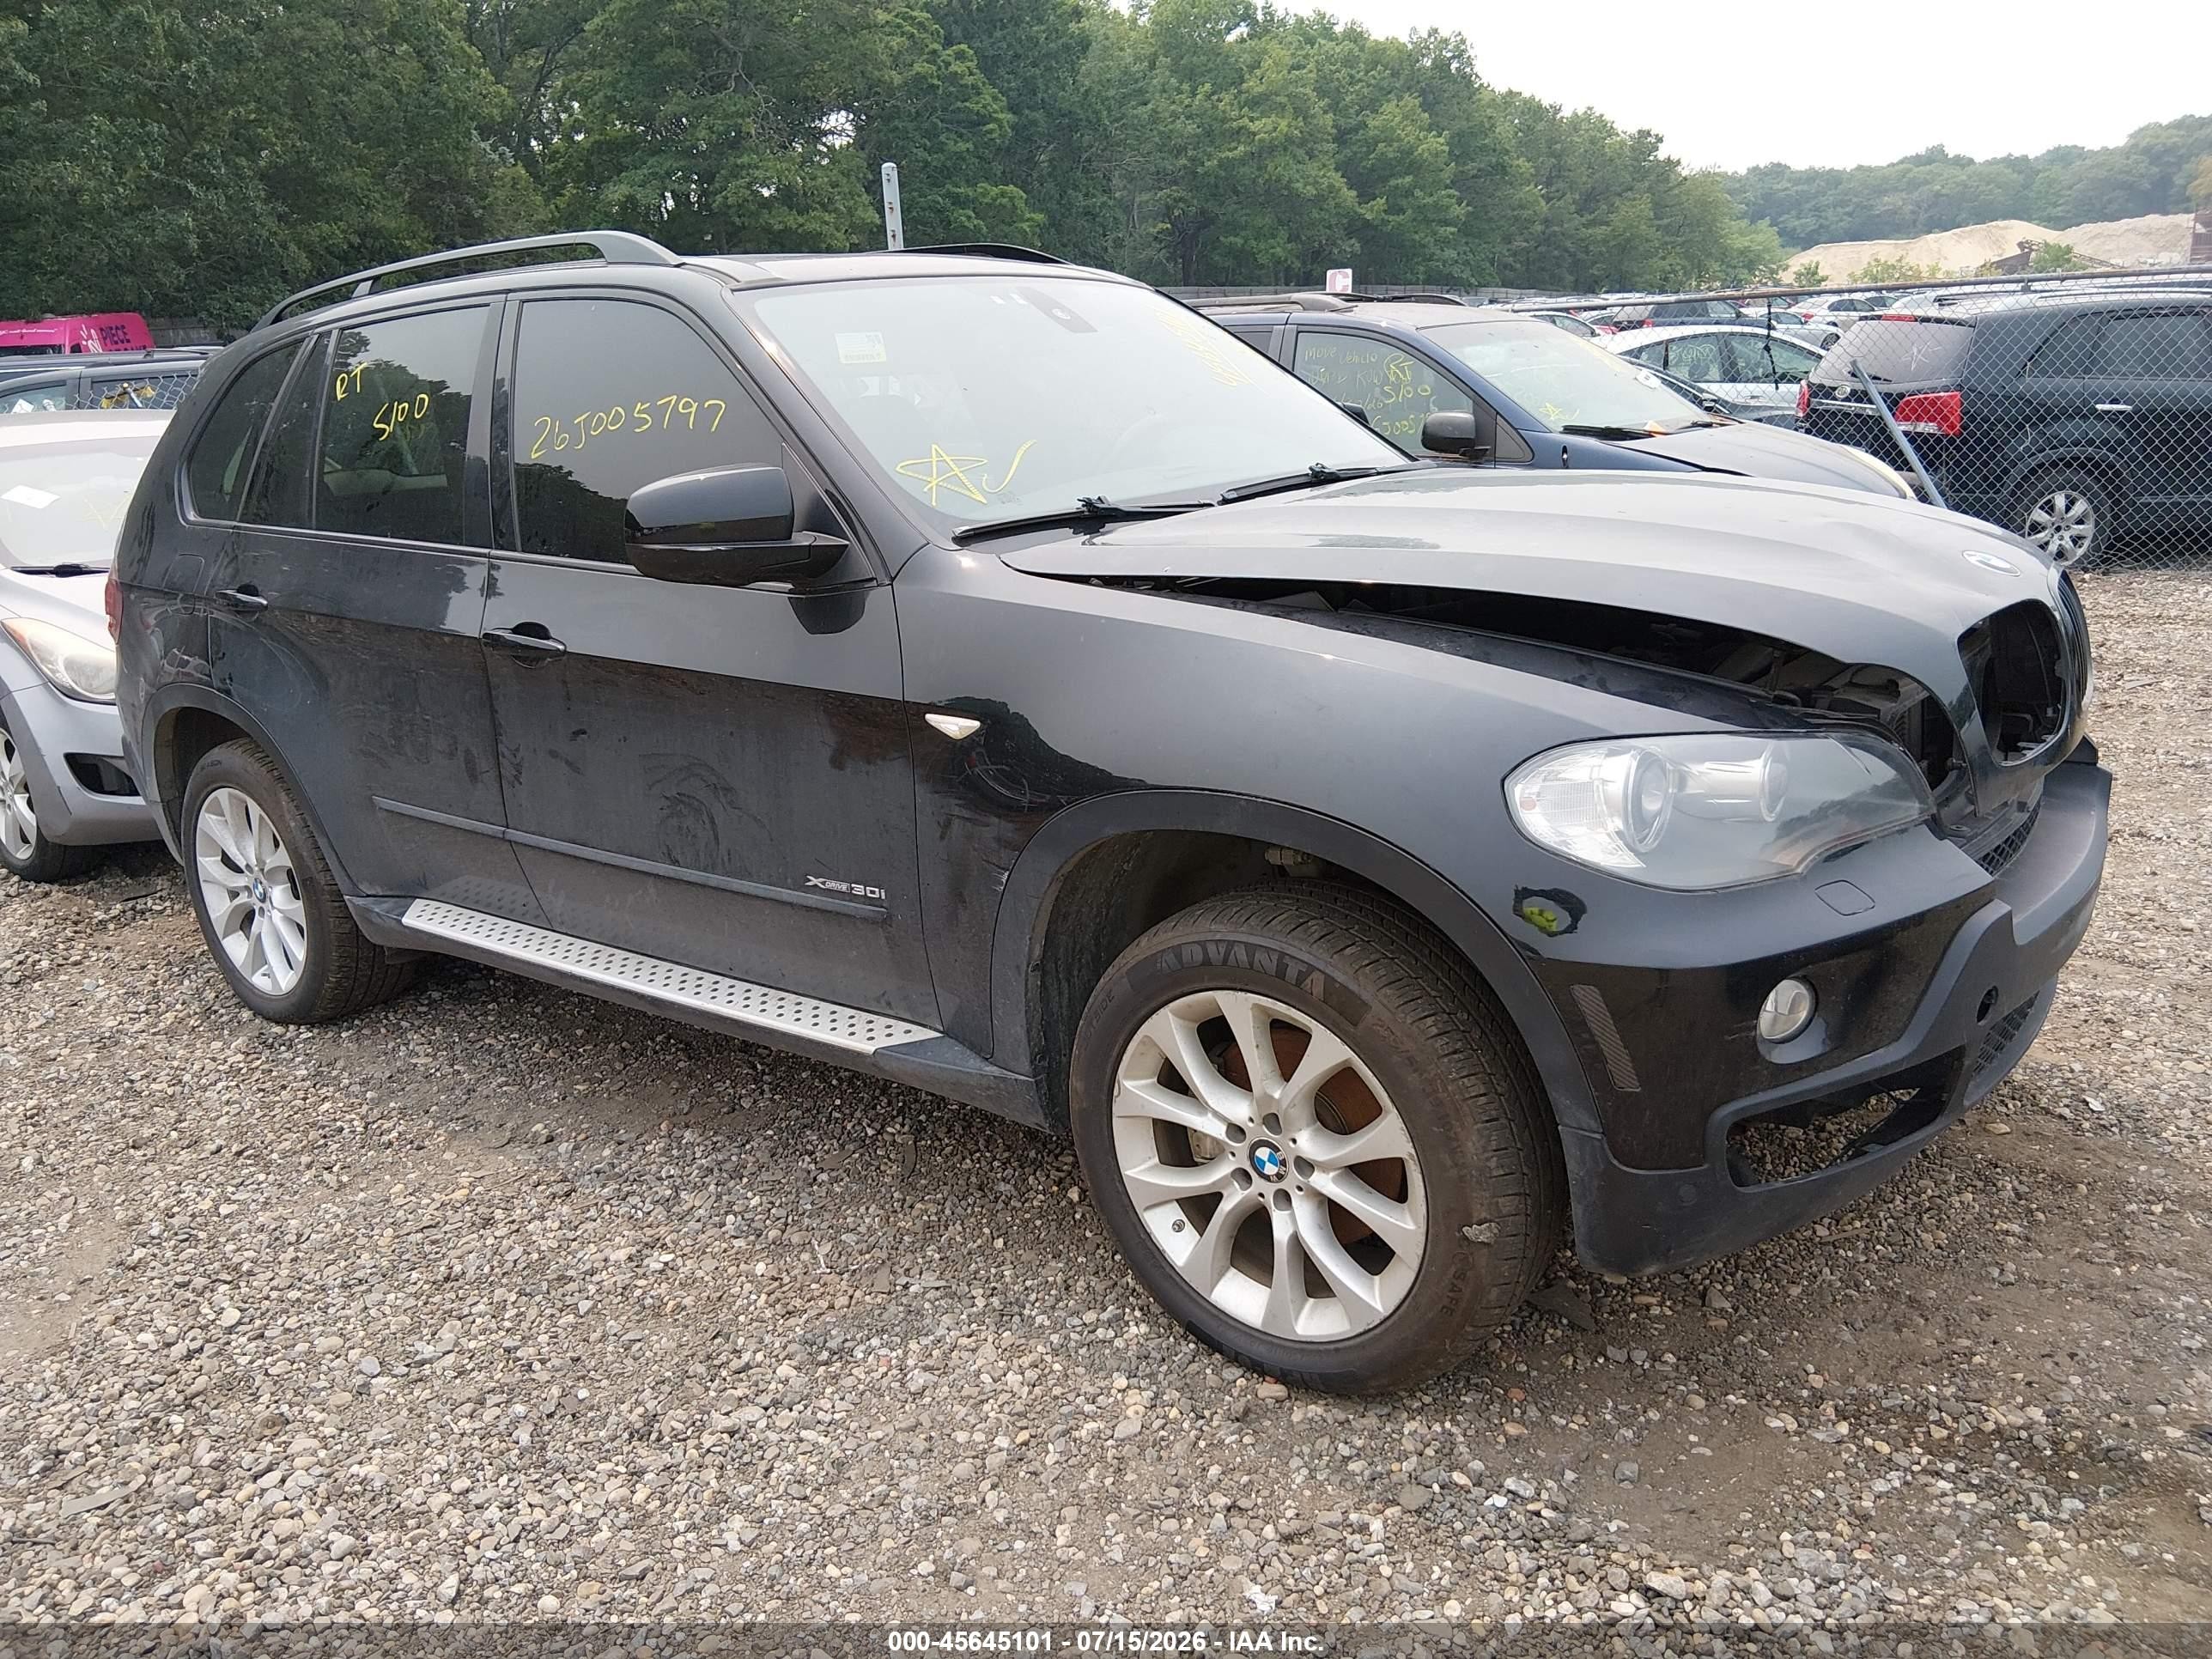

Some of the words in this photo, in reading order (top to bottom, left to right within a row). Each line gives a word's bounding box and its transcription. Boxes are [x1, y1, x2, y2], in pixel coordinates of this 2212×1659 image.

[99, 325, 131, 347] PIECE
[336, 362, 368, 401] RT
[531, 395, 726, 459] 26J005797
[1156, 939, 1326, 1002] ADVANTA
